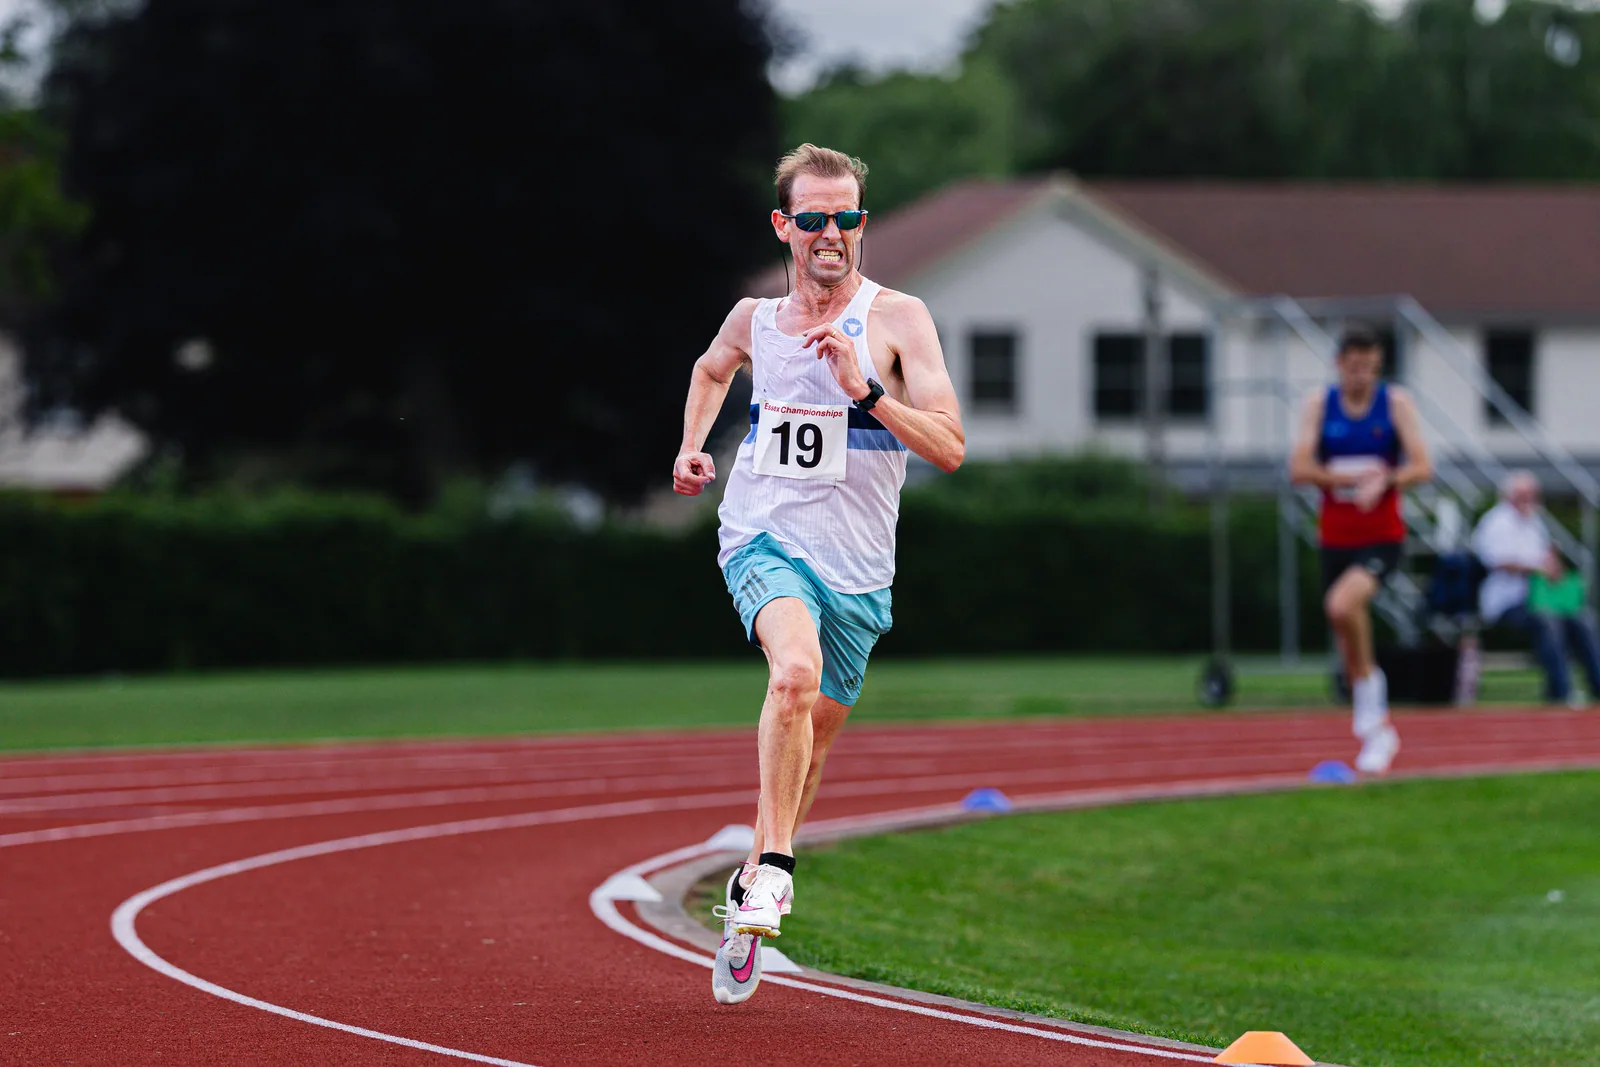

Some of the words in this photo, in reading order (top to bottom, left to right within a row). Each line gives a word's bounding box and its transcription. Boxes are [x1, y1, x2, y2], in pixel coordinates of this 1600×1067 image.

[764, 402, 780, 412] Essex
[780, 406, 843, 418] Championships
[771, 421, 823, 468] 19
